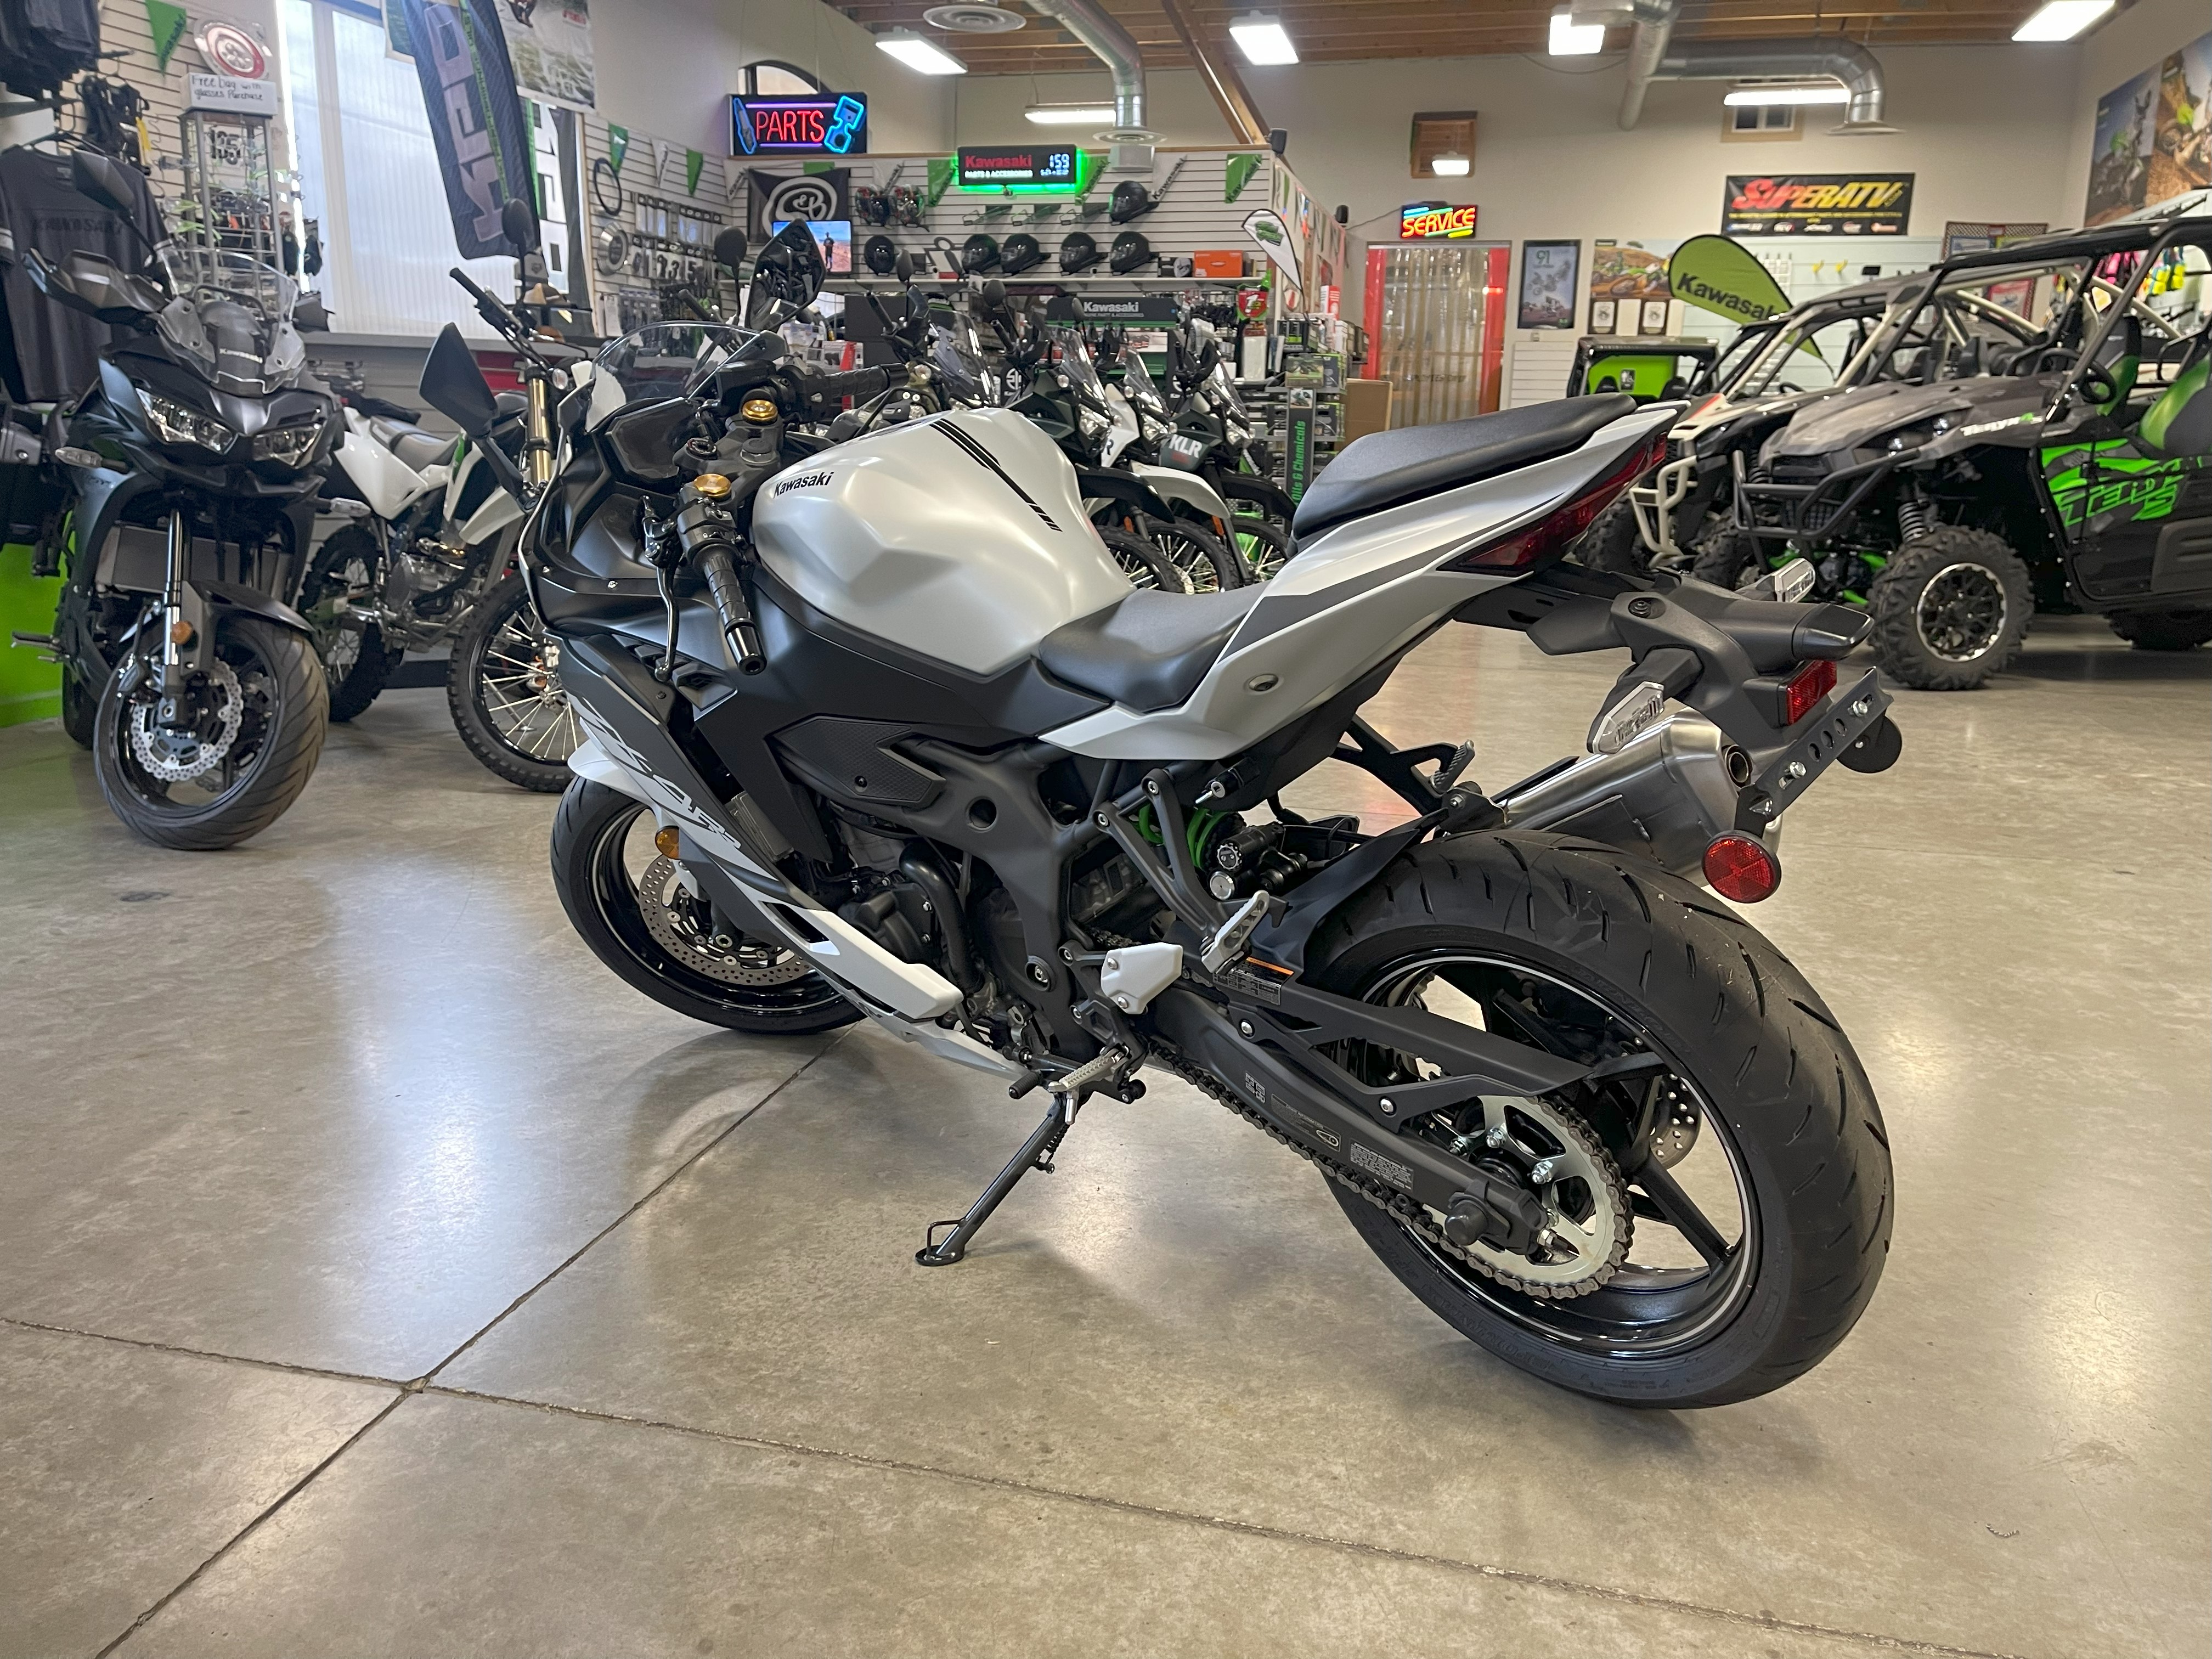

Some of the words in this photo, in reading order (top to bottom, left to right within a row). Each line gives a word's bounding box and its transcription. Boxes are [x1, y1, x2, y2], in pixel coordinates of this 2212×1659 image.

[192, 75, 216, 88] Free
[755, 110, 825, 143] PARTS
[964, 154, 1032, 168] Kawasaki
[1402, 207, 1476, 238] SERVICE
[1084, 302, 1139, 312] Kawasaki
[1677, 272, 1778, 320] Kawasak
[1169, 434, 1203, 458] KLR
[773, 472, 834, 499] Kawasaki
